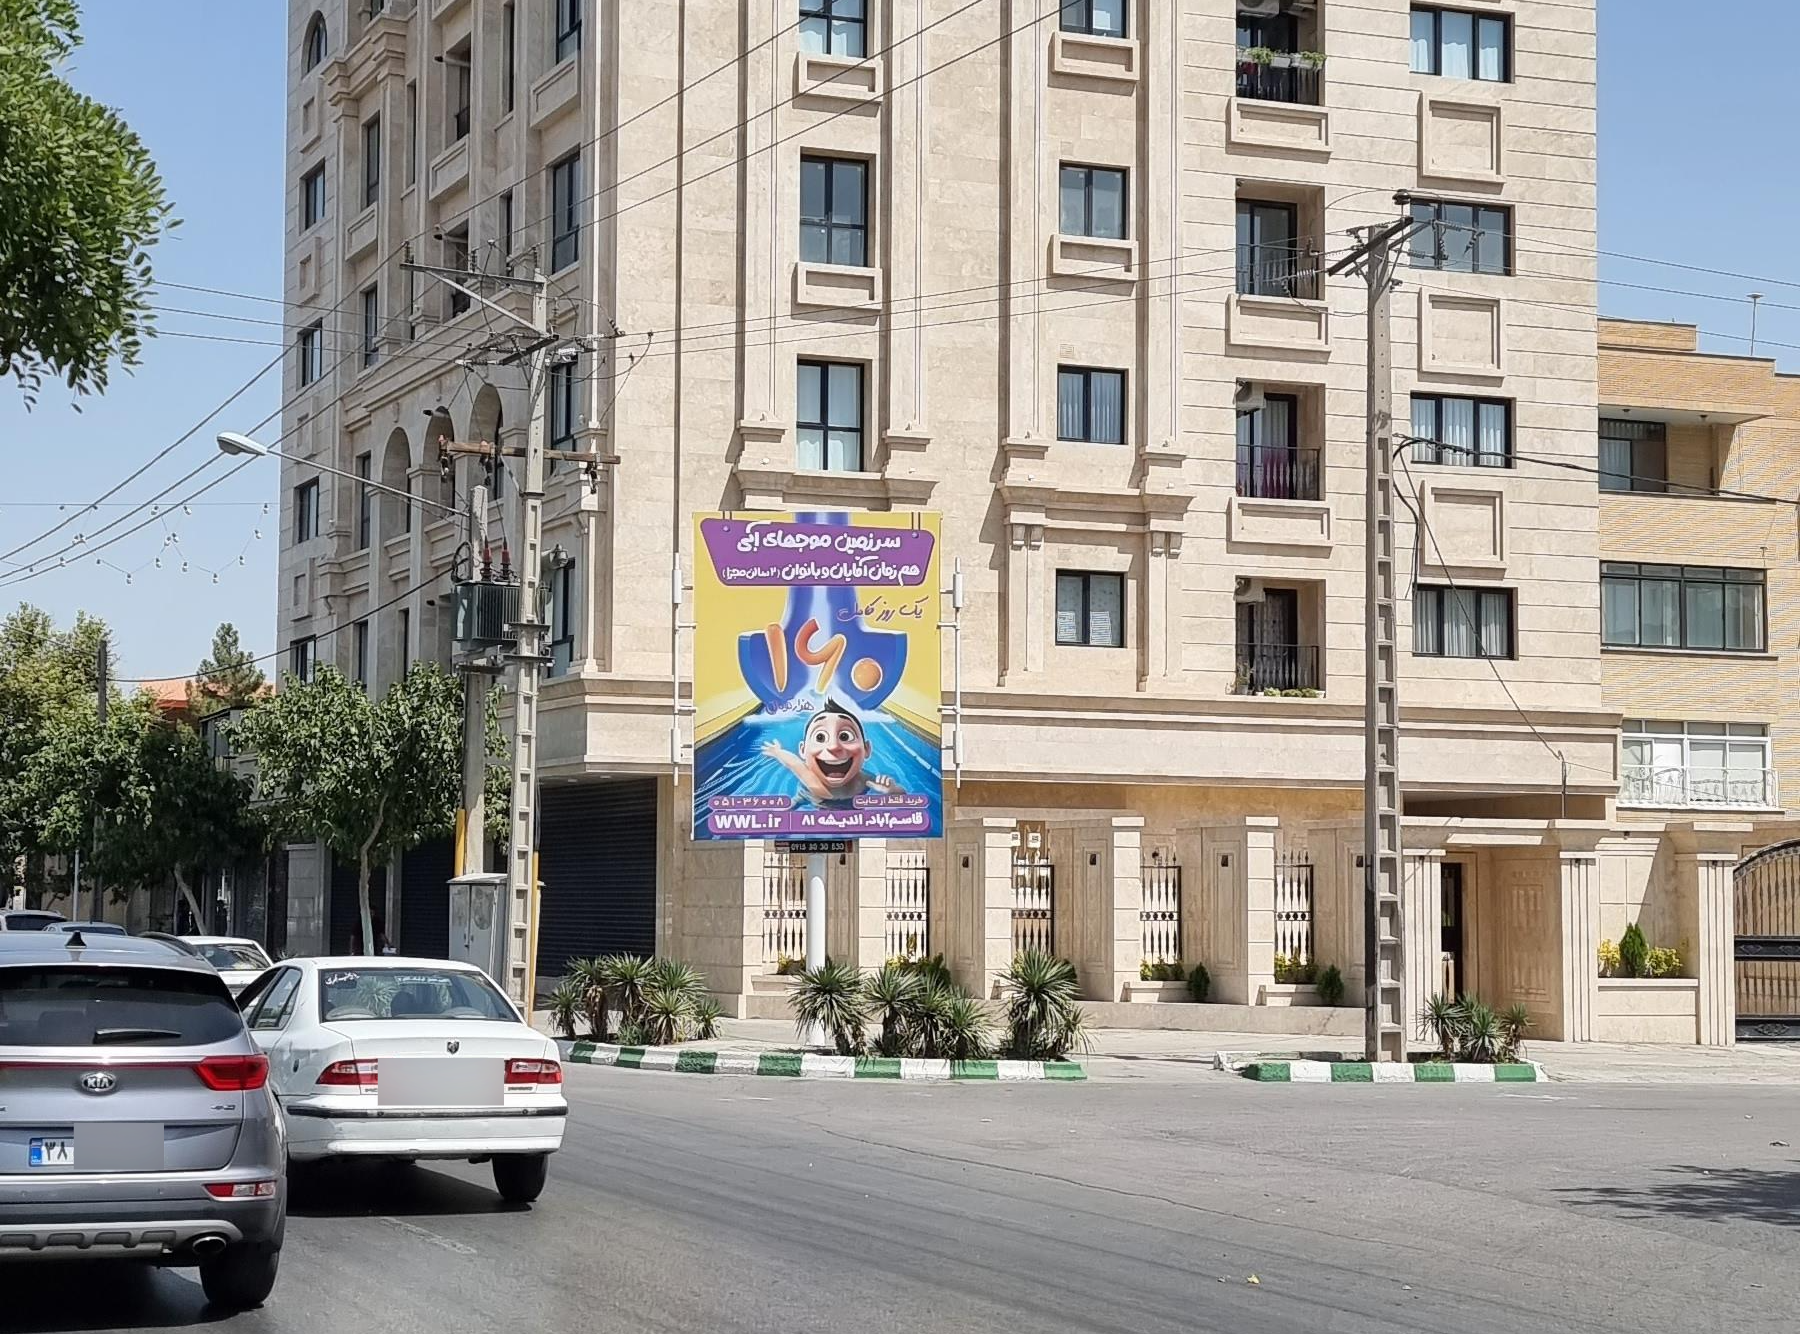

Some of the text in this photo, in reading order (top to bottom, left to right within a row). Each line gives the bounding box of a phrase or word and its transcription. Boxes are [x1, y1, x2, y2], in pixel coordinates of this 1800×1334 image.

[737, 520, 772, 552] آبی
[834, 532, 901, 554] سرزمین
[781, 561, 821, 580] بانوان
[829, 555, 879, 581] آقایان
[868, 561, 897, 581] زمان
[837, 595, 929, 622] یک روز کامل
[765, 618, 883, 694] ۱۶۰
[855, 794, 924, 806] خرید فقط از سایت
[714, 814, 782, 829] WWL.ir
[801, 814, 815, 826] ۸۱
[817, 813, 863, 828] اندیشه
[86, 1076, 111, 1089] KIA
[44, 1141, 68, 1161] ۳۸
